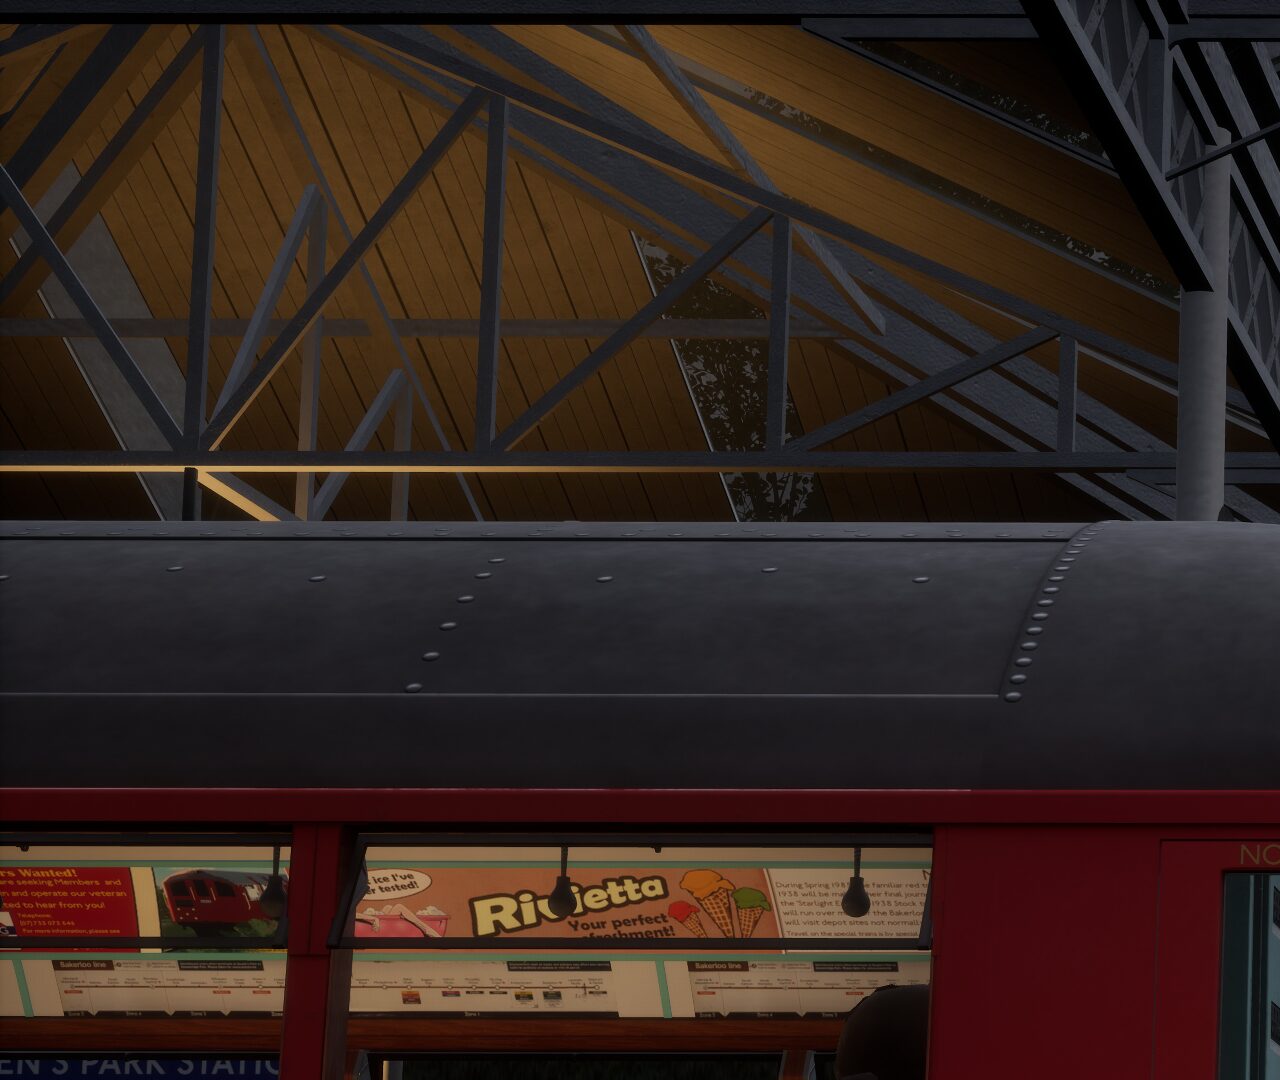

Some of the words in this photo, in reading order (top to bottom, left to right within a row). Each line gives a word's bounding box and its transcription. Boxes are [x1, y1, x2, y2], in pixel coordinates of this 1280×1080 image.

[18, 869, 78, 877] Wanted!
[372, 876, 390, 884] ice
[391, 873, 414, 882] I've
[378, 881, 419, 893] tested!
[86, 902, 105, 910] you!
[568, 920, 606, 931] Your
[612, 913, 668, 929] perfect
[81, 1060, 166, 1075] PARK
[177, 1060, 279, 1075] STATIO
